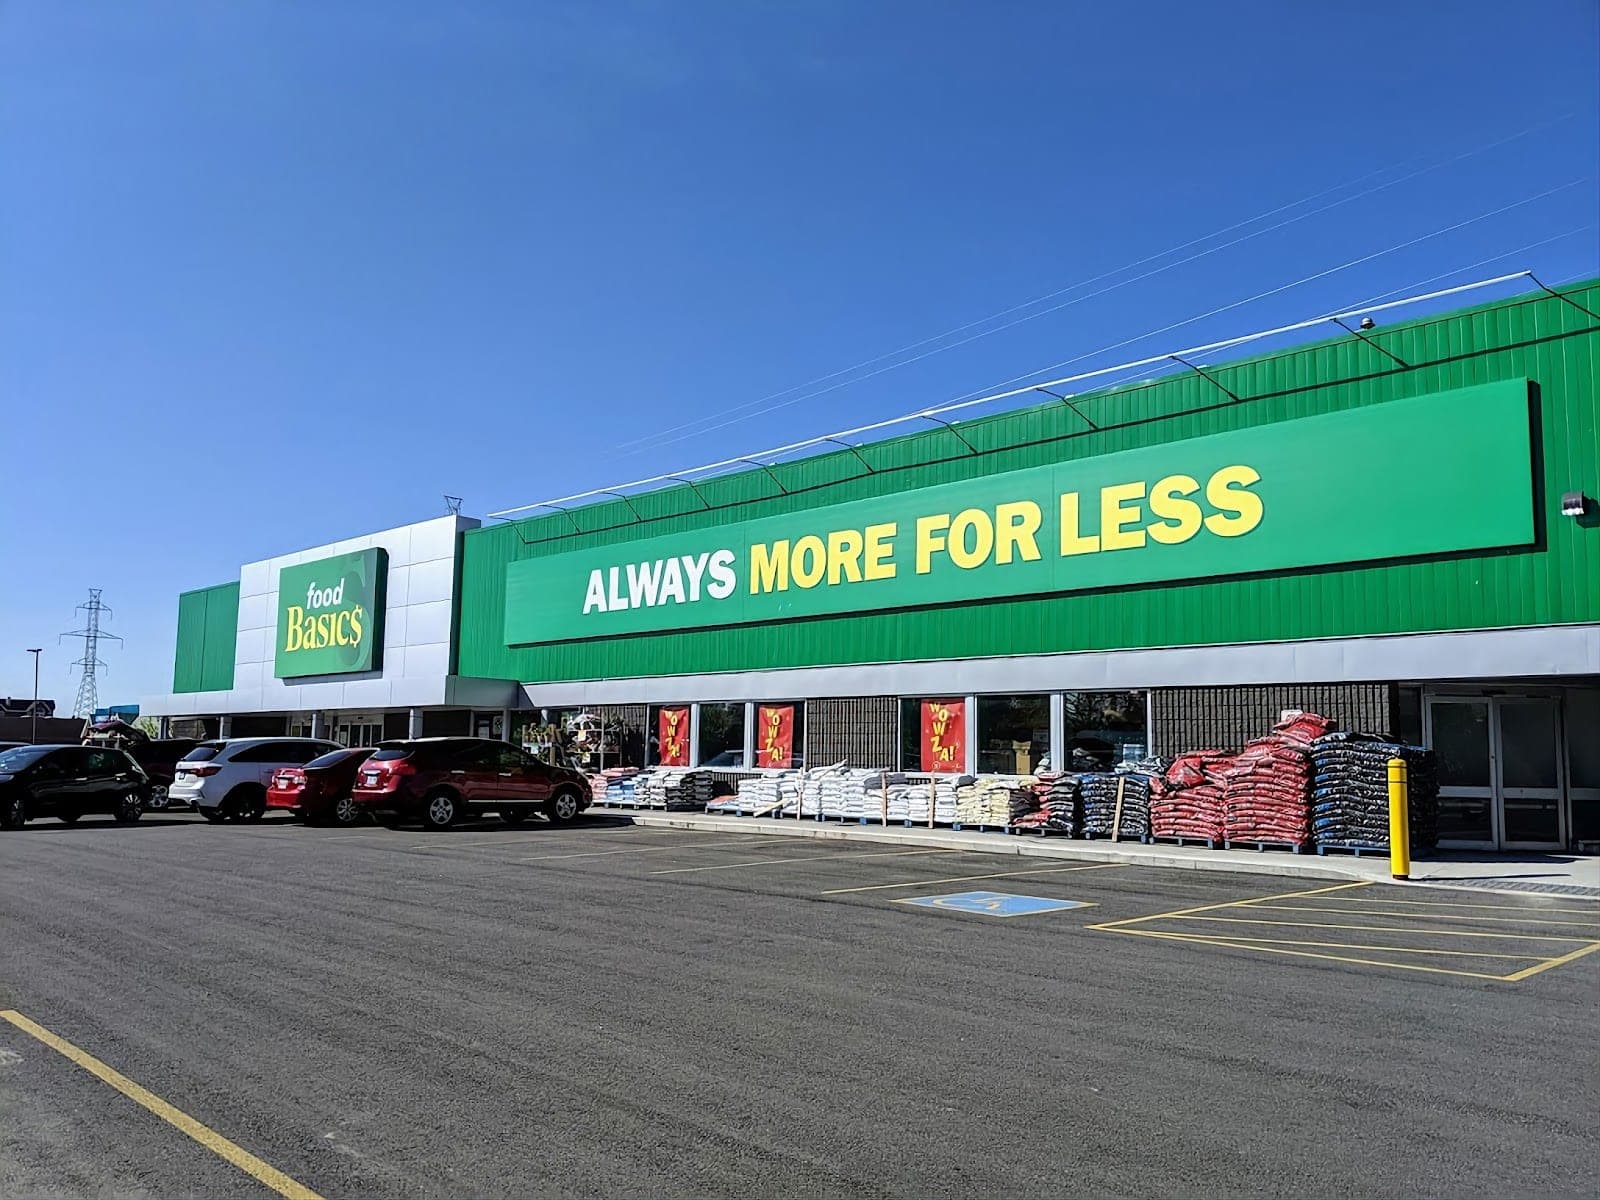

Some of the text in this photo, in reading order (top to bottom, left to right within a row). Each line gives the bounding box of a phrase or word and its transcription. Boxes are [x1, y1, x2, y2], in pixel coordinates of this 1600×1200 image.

[583, 465, 1264, 615] ALWAYS MORE FOR LESS
[306, 578, 345, 610] food
